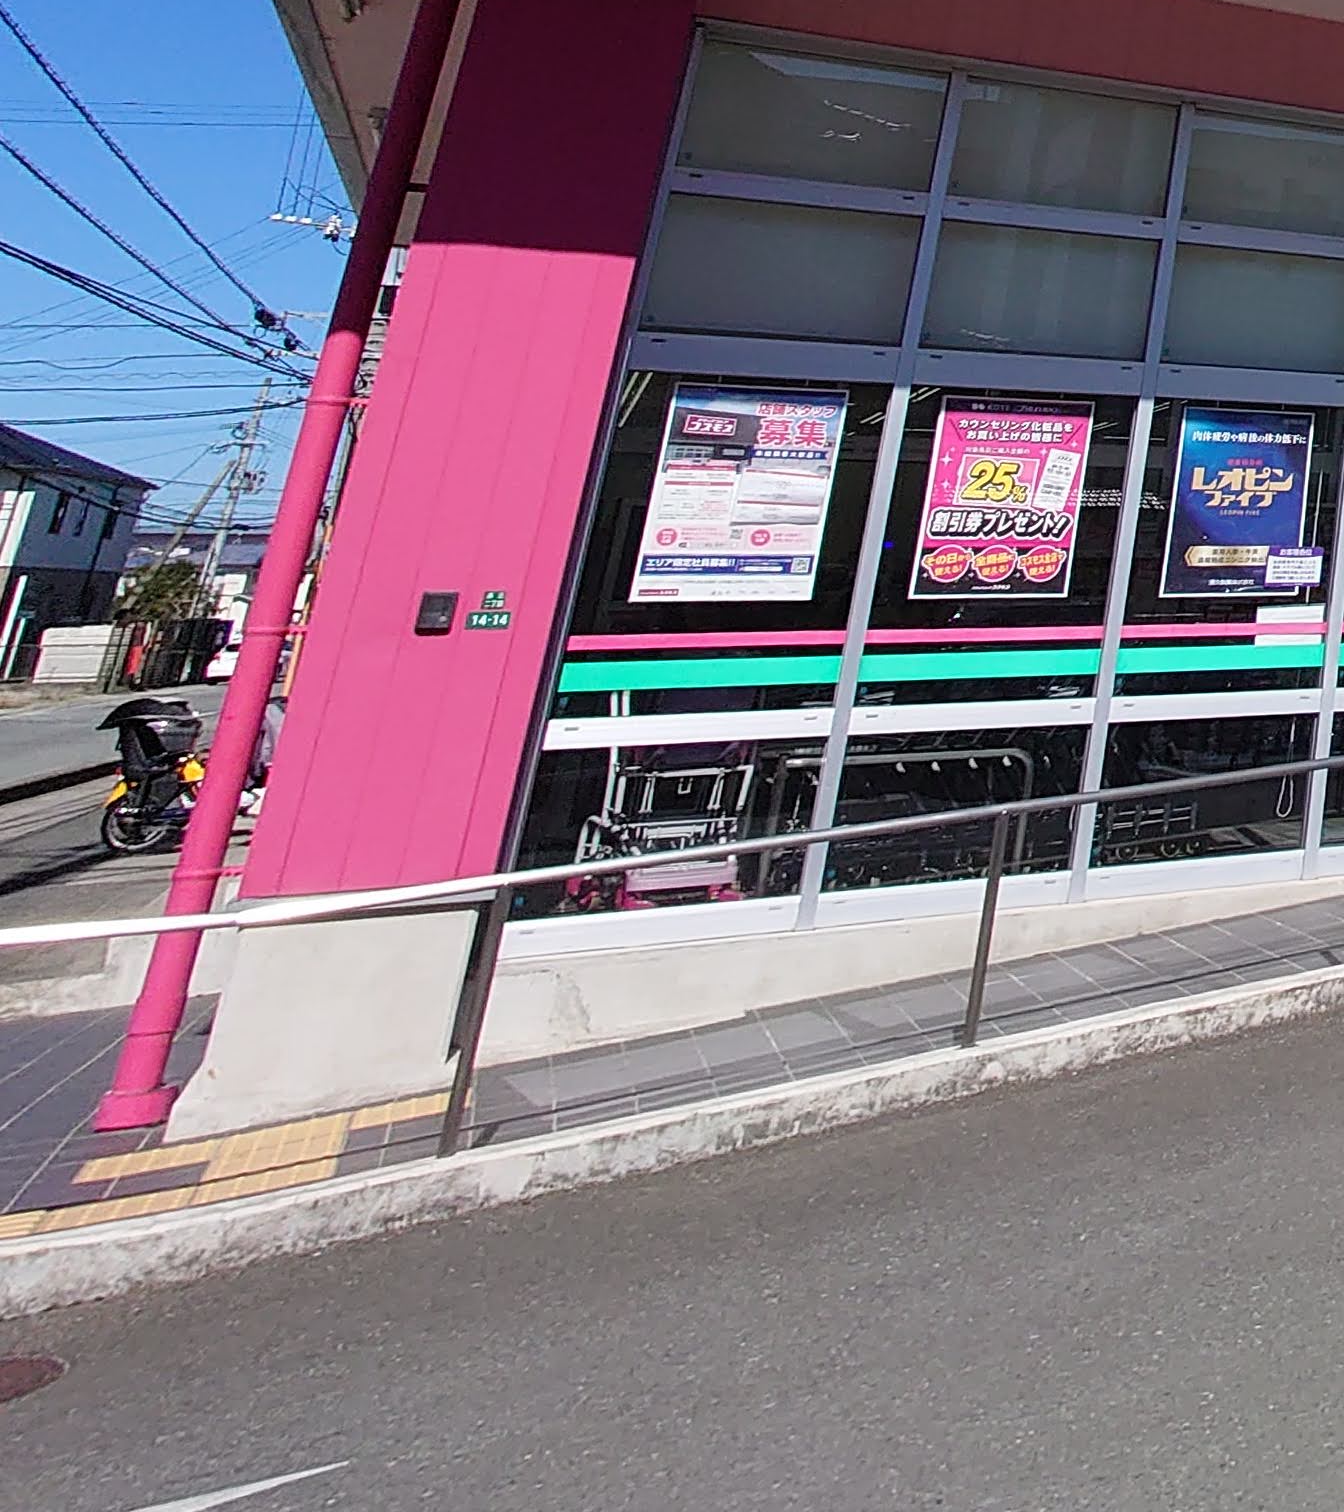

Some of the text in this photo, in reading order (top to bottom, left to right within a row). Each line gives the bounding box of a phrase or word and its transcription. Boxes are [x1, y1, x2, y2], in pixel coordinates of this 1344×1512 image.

[688, 421, 734, 433] コスモス
[759, 418, 827, 447] 募集
[960, 459, 1028, 503] 25%
[1191, 466, 1294, 492] レオピン
[1204, 490, 1277, 508] ファイブ
[471, 614, 509, 626] 14-14
